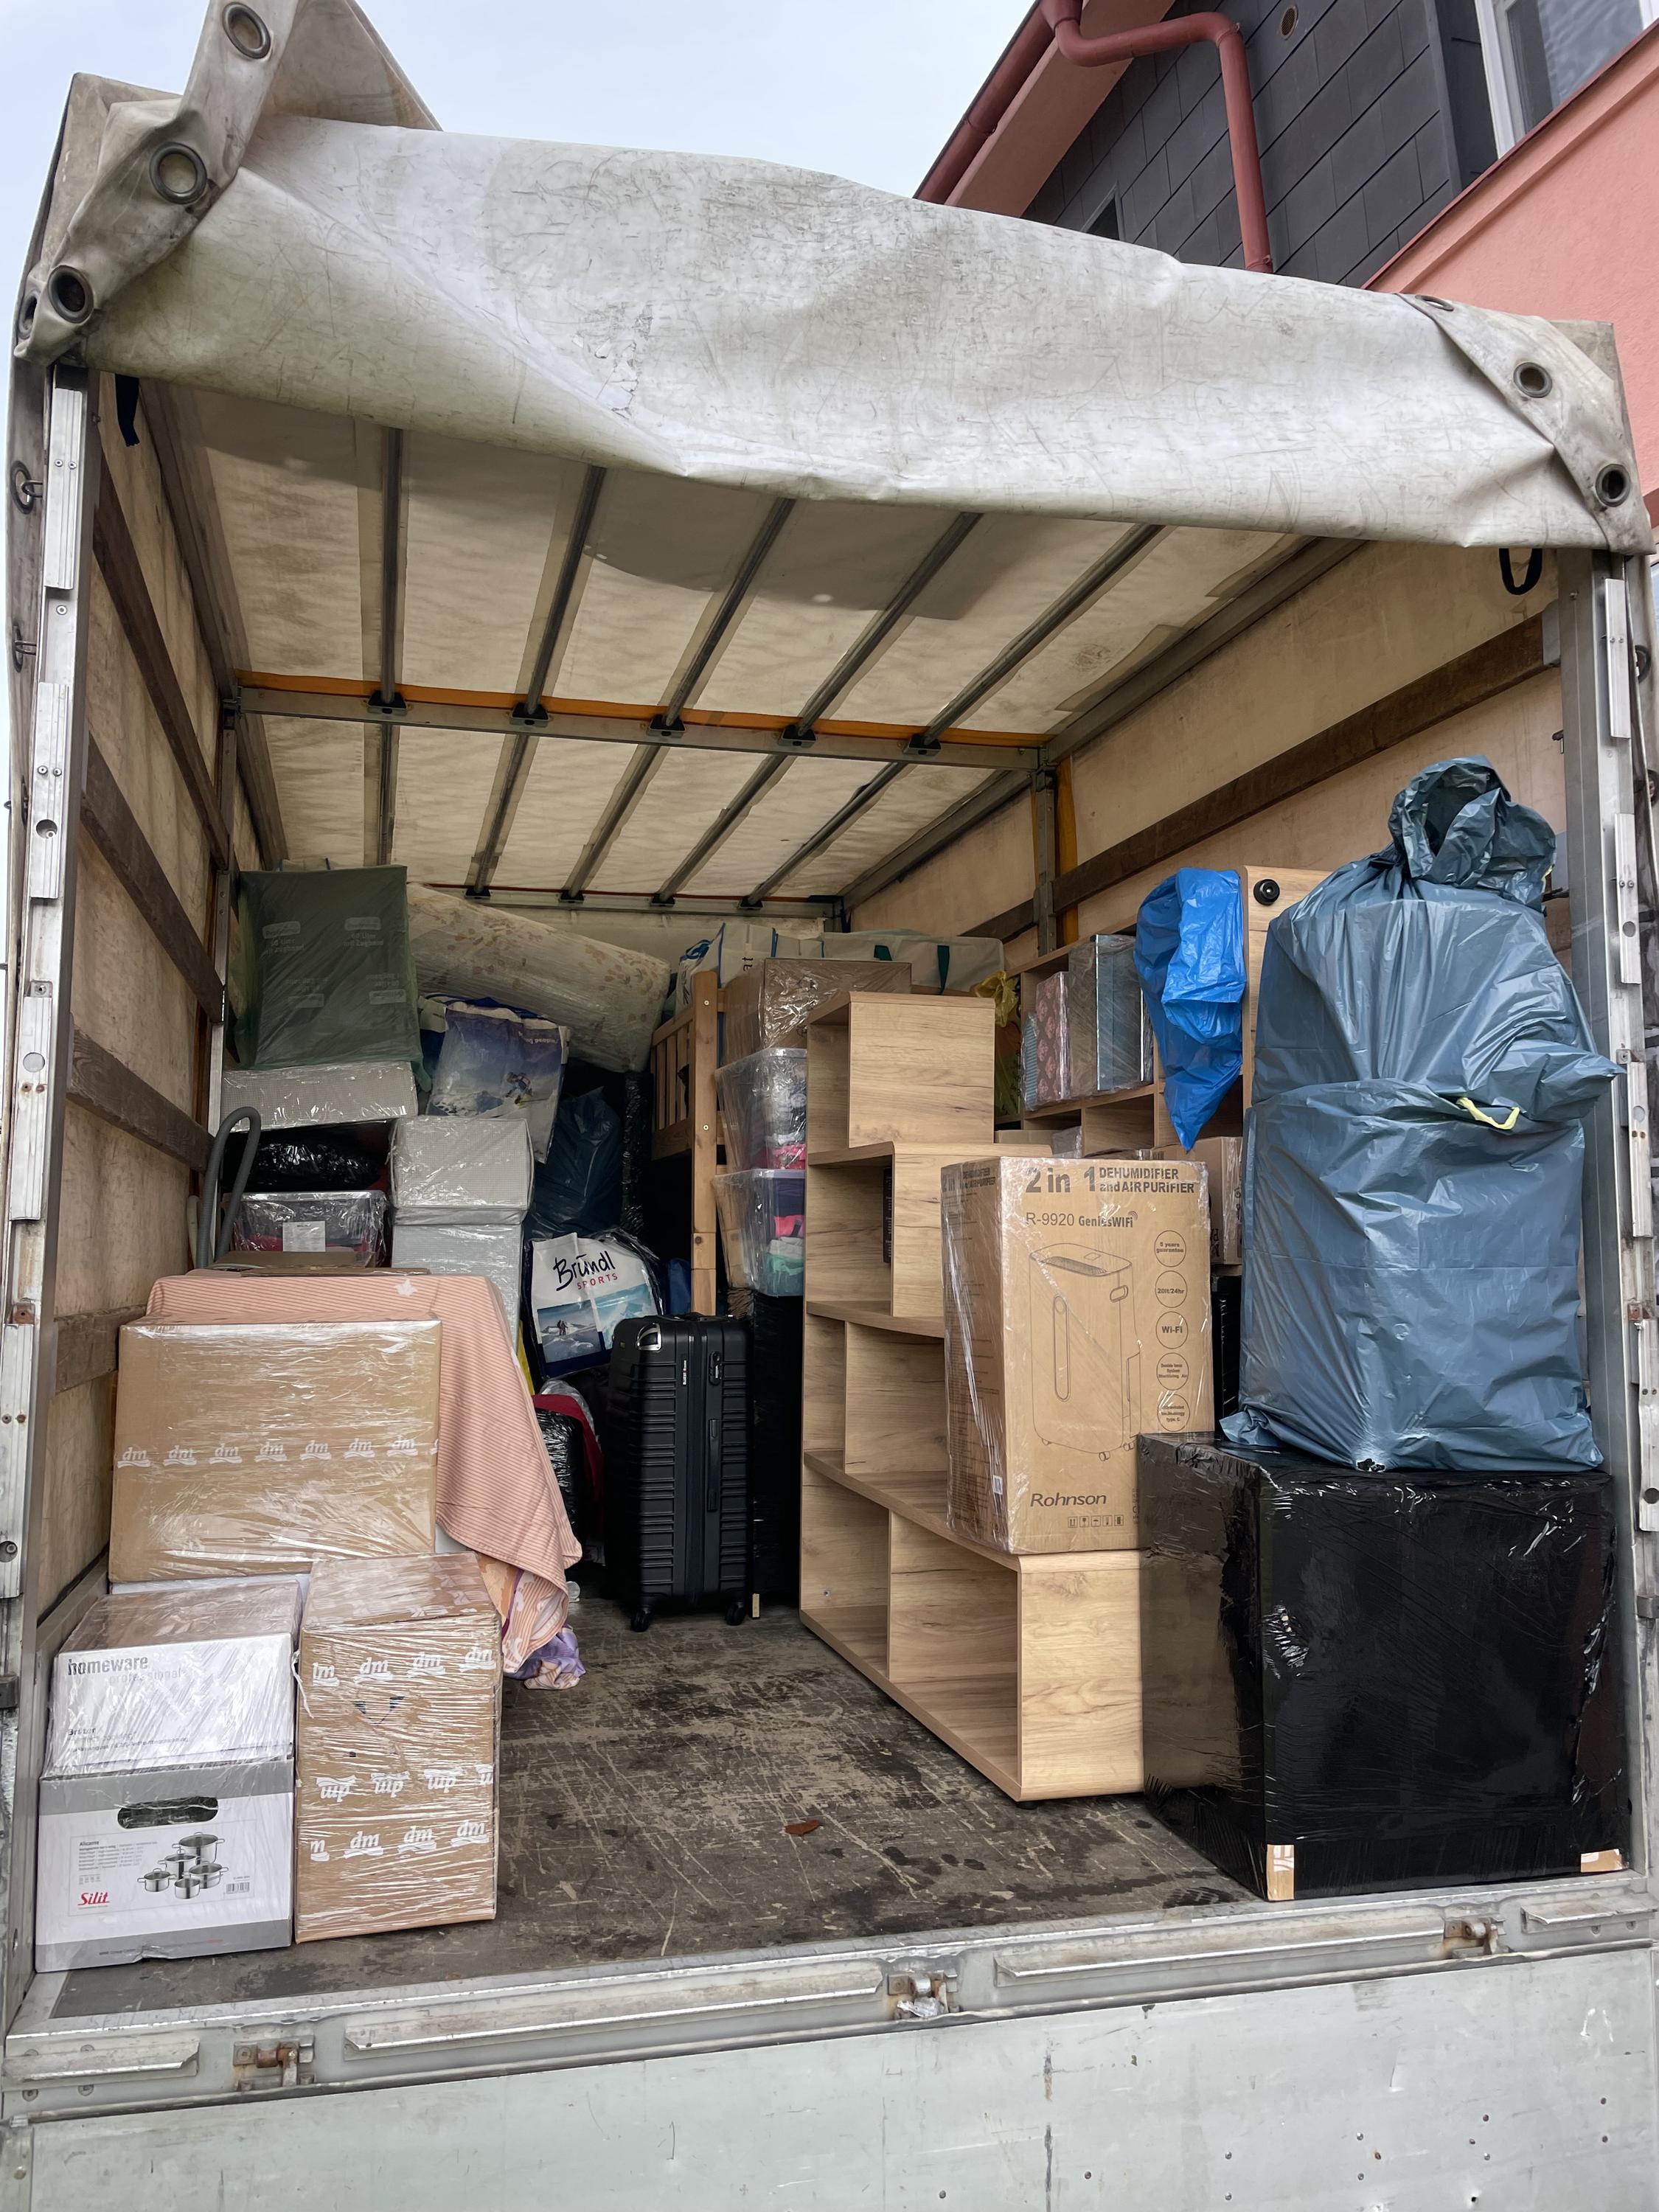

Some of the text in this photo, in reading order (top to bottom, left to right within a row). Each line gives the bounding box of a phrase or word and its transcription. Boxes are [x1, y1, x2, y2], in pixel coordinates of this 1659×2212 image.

[1025, 1166, 1096, 1193] 2 in 1
[1099, 1166, 1179, 1180] DEHUMIDIFIER
[1026, 1211, 1075, 1226] R-9920
[577, 1273, 618, 1290] SPORTS
[1161, 1325, 1183, 1334] Wi-Fi
[122, 1447, 147, 1461] dm
[168, 1444, 194, 1459] dm
[214, 1443, 240, 1458] dm
[260, 1441, 284, 1456] dm
[305, 1439, 329, 1453] dm
[349, 1438, 372, 1452] dm
[1029, 1492, 1107, 1508] Rohnson
[68, 1656, 148, 1675] homeware
[359, 1657, 389, 1675] dm
[412, 1651, 442, 1669] dm
[465, 1646, 493, 1664] dm
[349, 1830, 380, 1849] dm
[403, 1825, 434, 1844] dm
[456, 1819, 485, 1837] dm
[79, 1891, 110, 1906] Silit
